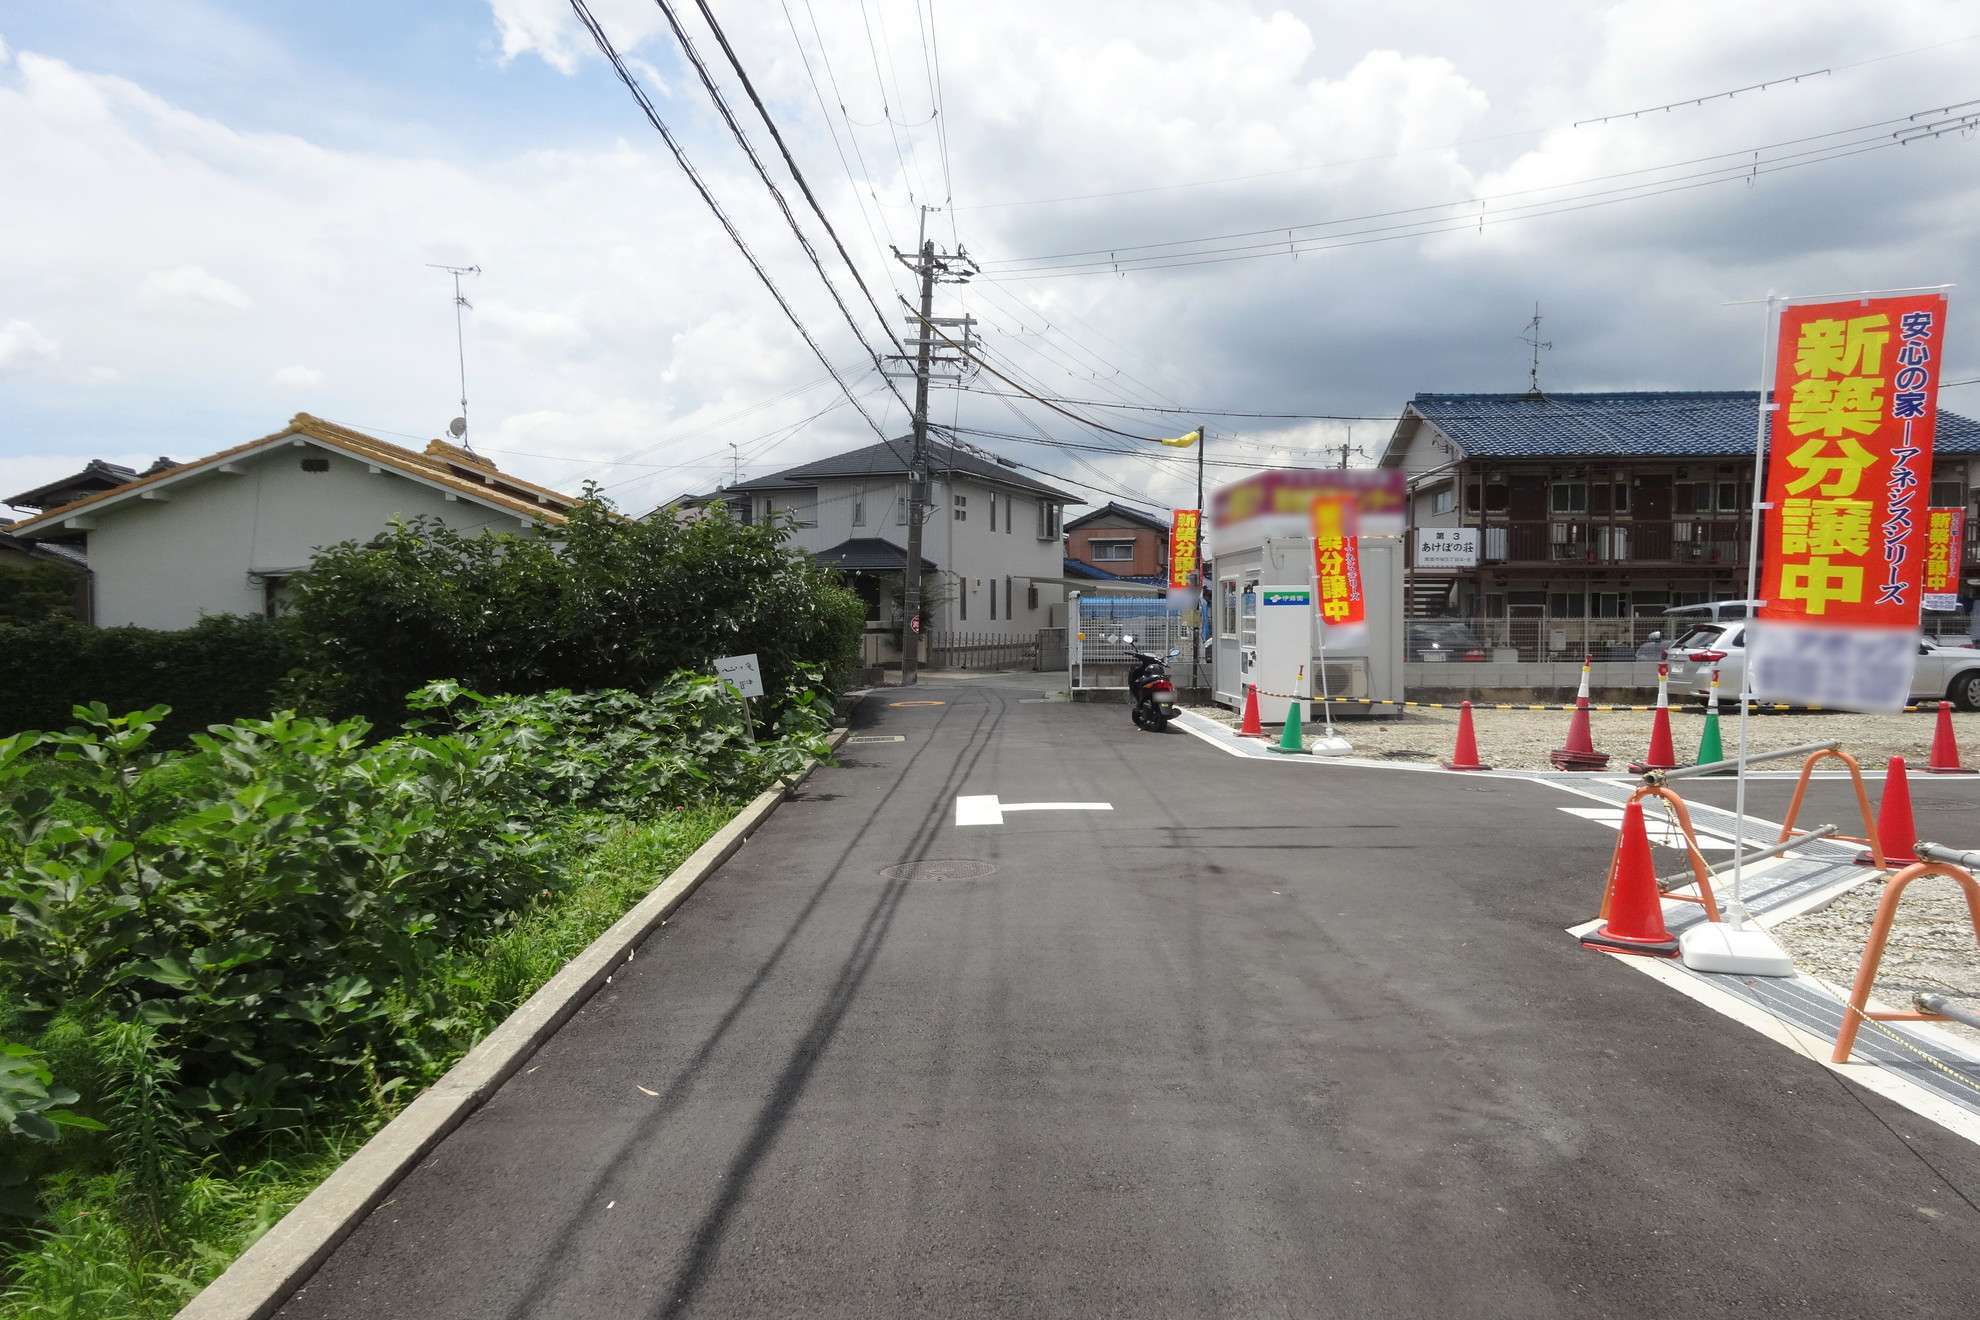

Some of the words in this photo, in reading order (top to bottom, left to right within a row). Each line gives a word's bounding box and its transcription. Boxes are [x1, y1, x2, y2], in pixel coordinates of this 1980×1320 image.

[1779, 313, 1891, 615] 新築分譲中
[1421, 541, 1474, 553] あけぼの荘
[1927, 512, 1952, 591] 新築分譲中
